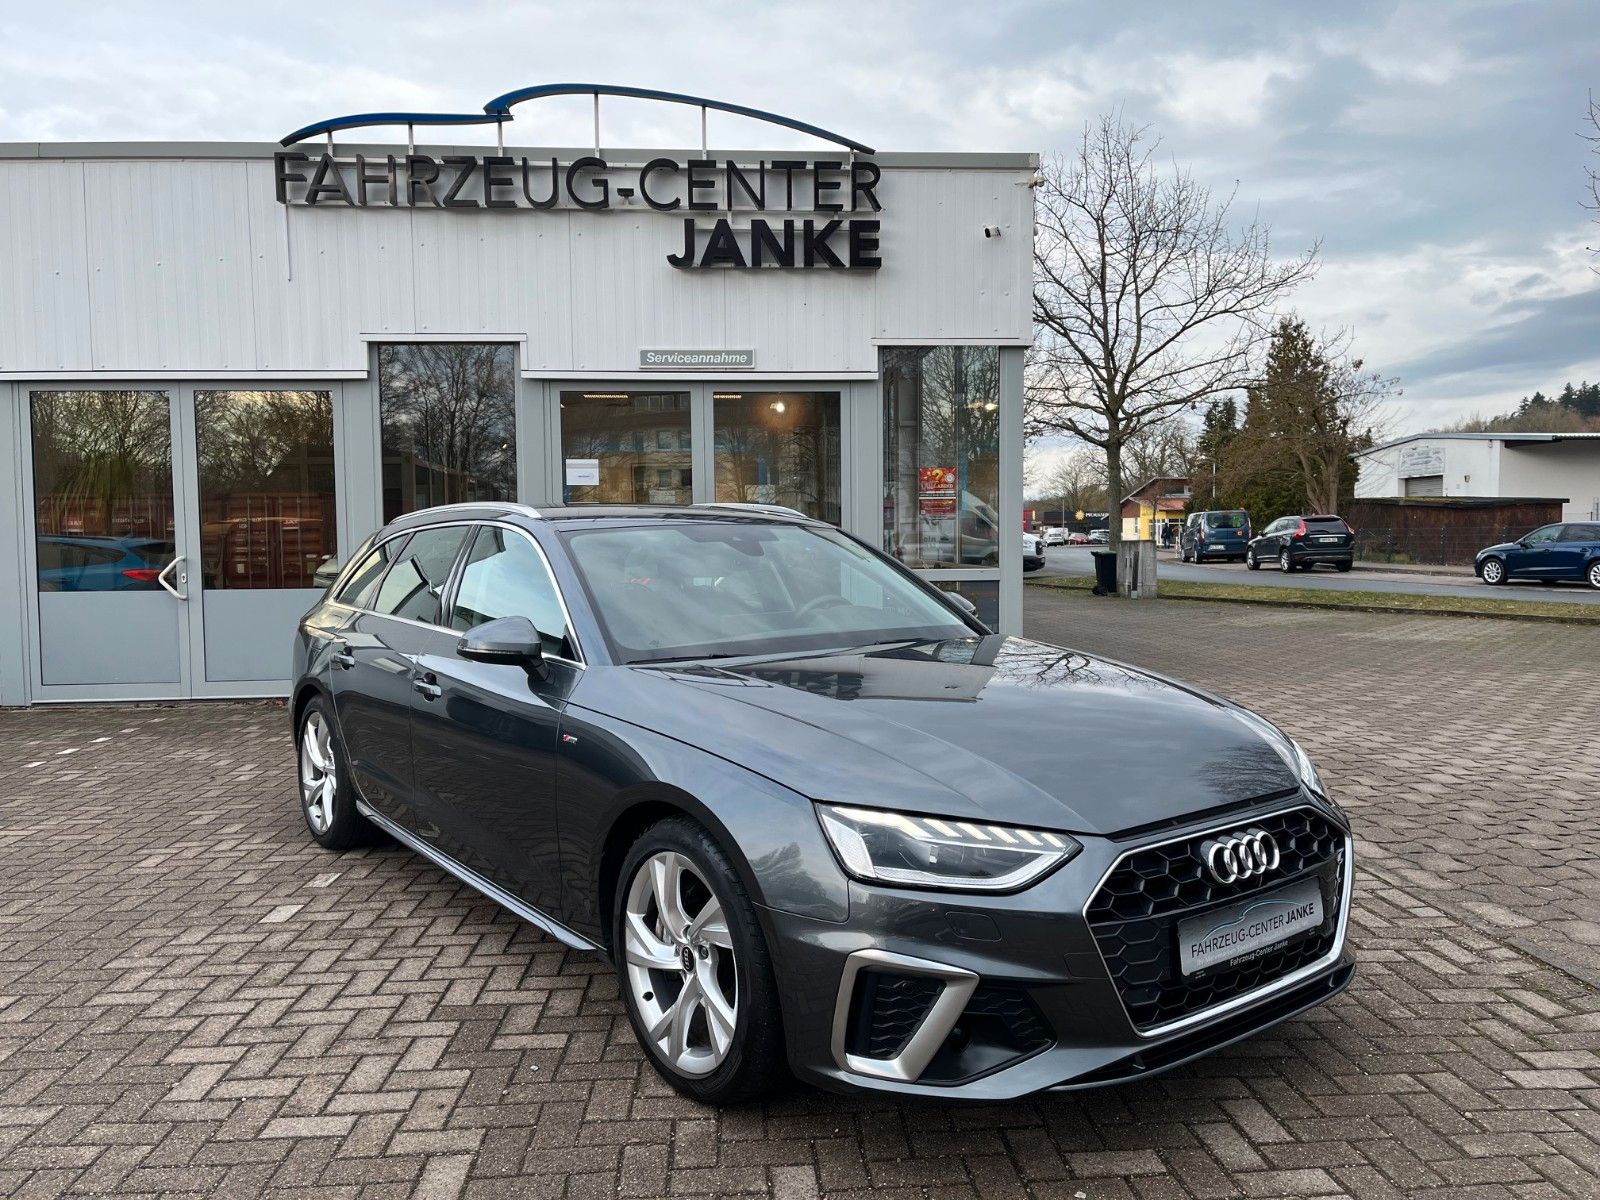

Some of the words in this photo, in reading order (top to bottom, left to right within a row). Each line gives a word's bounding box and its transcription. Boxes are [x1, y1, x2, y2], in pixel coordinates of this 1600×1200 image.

[274, 151, 882, 212] FAHRZEUG-CENTER
[666, 218, 882, 269] JANKE
[646, 351, 748, 364] Serviceannahme
[1191, 914, 1284, 958] FAHRZEUG-CENTER
[1285, 902, 1314, 924] JANKE
[1229, 945, 1273, 967] Fahrzeug-Center
[1273, 940, 1288, 952] Janke
